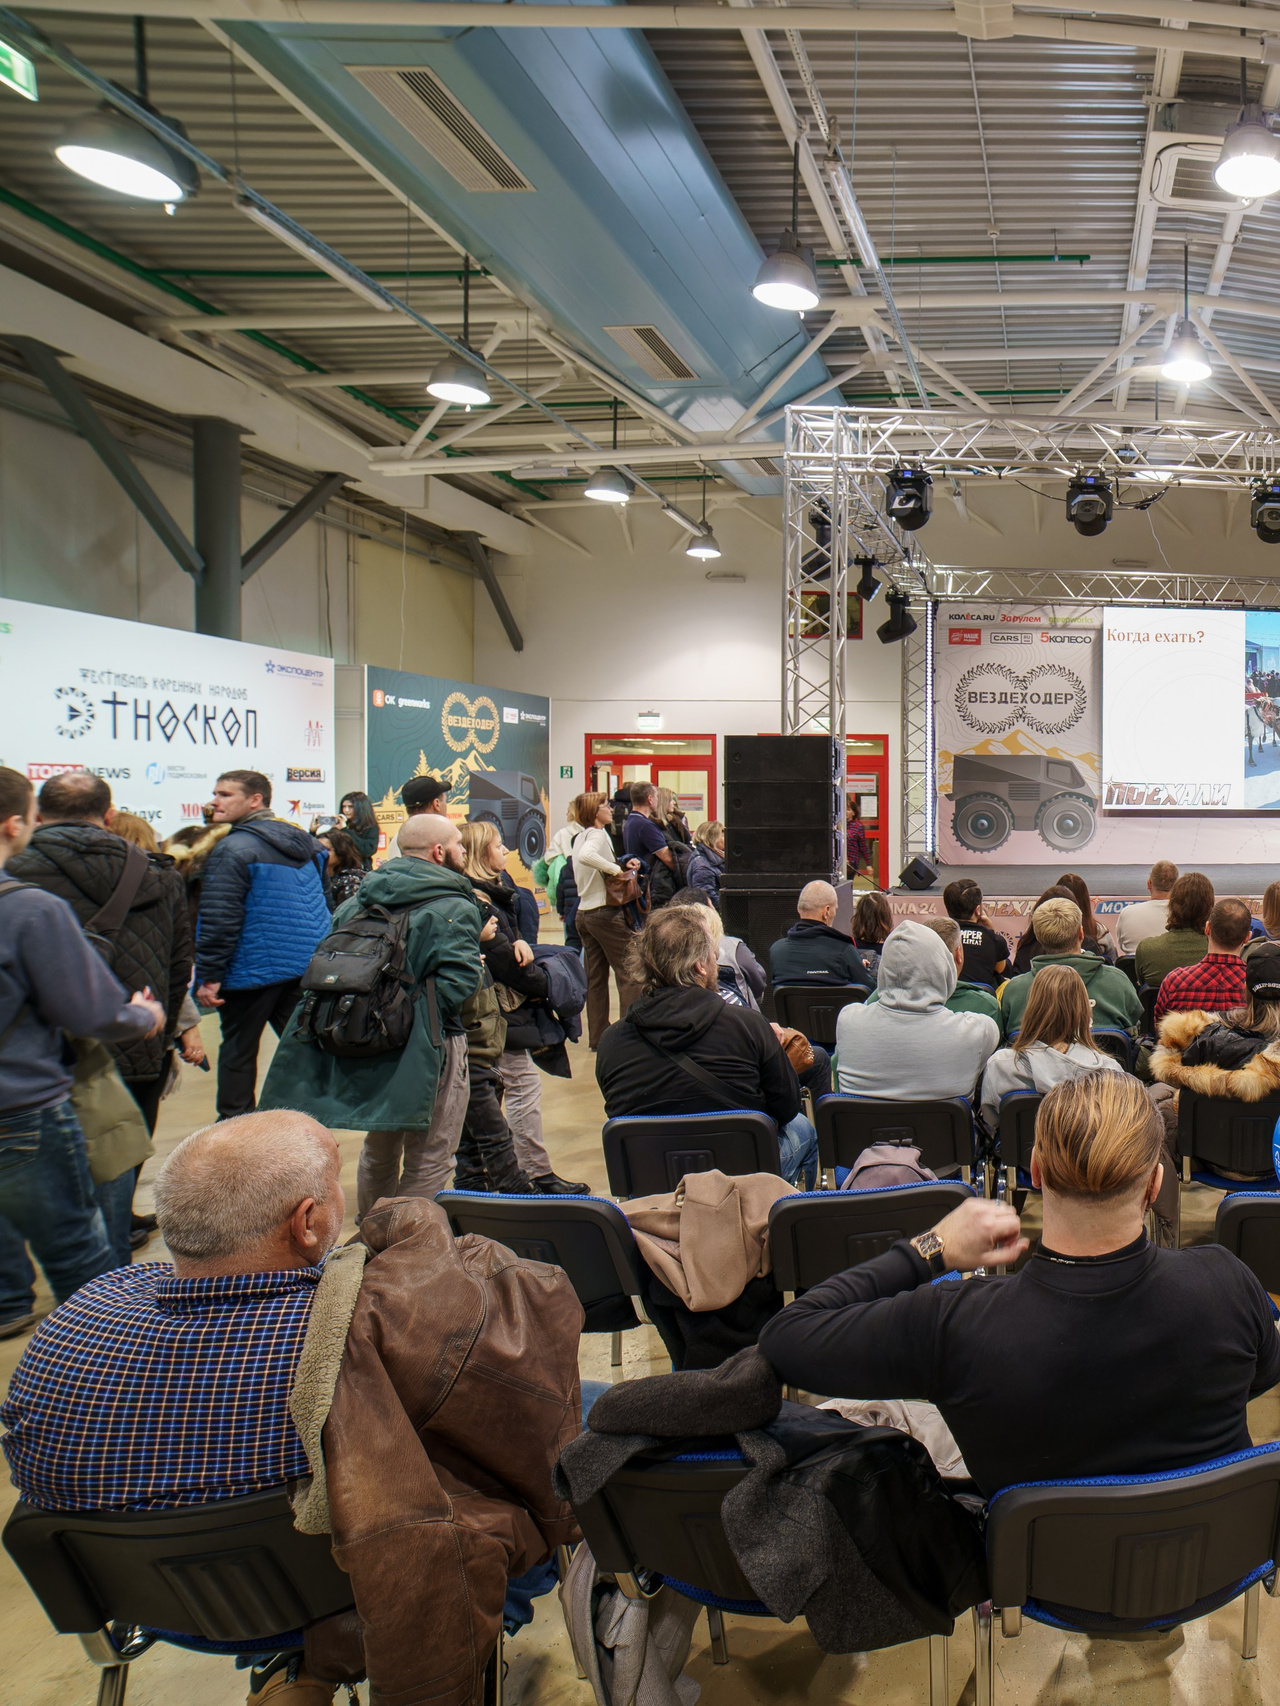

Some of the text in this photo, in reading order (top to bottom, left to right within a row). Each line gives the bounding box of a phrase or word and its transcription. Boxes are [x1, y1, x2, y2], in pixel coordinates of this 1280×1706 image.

[1048, 615, 1094, 624] greenworks
[1107, 629, 1205, 644] Когда ехать?
[967, 691, 1074, 705] ВЕЗДЕХОДЕР
[447, 715, 495, 731] ВЕЗДЕХОДЕР
[287, 768, 322, 781] Версия
[1104, 783, 1232, 806] ПОЕХАЛИ
[919, 902, 938, 915] 24
